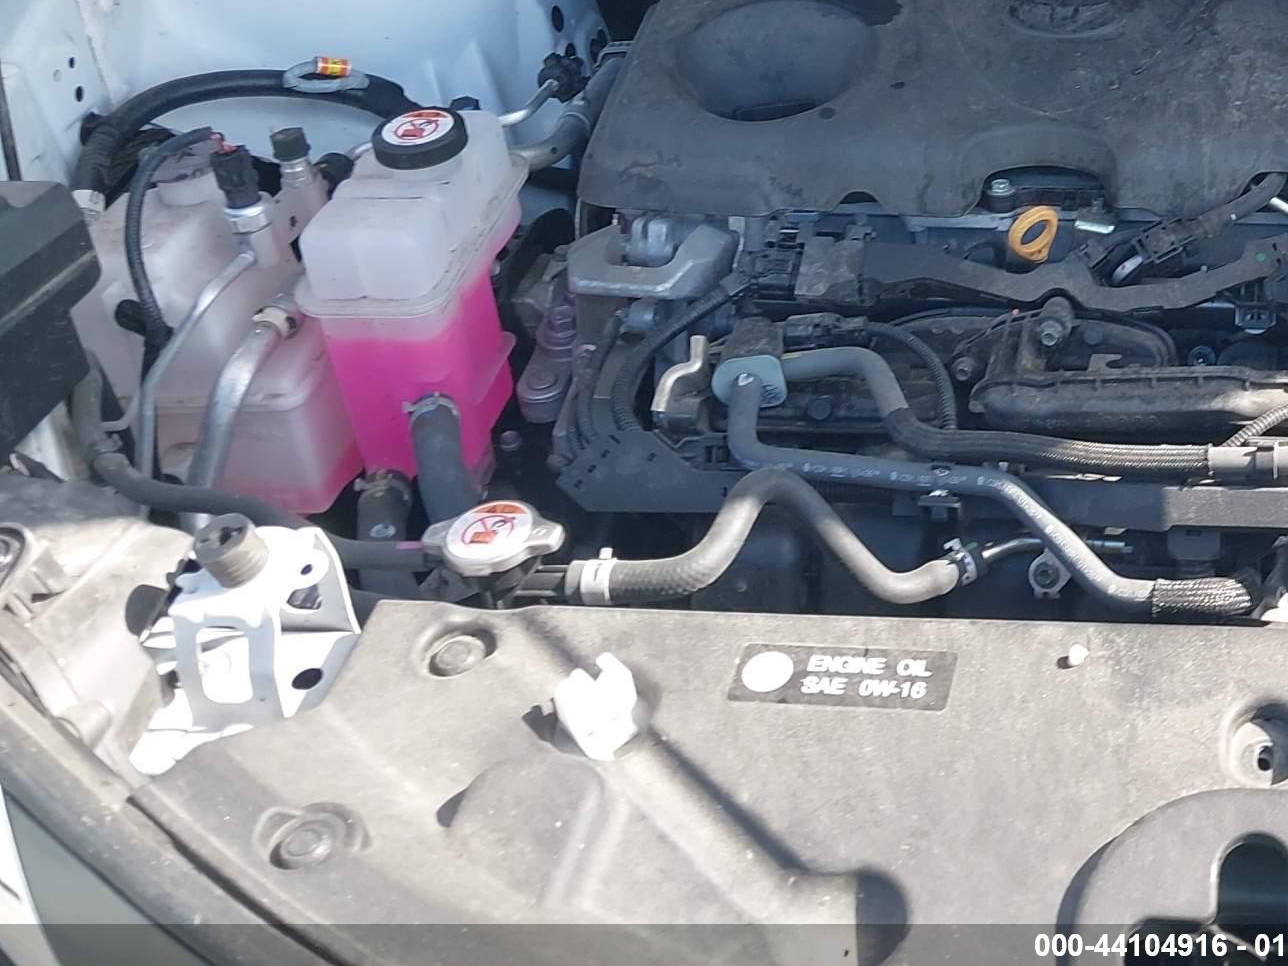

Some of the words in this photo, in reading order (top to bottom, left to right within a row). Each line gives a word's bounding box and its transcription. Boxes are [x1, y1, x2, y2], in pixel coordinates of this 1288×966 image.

[807, 654, 888, 675] ENGINE
[896, 658, 933, 677] OIL
[800, 675, 849, 696] SAE
[858, 680, 928, 699] 0W-16
